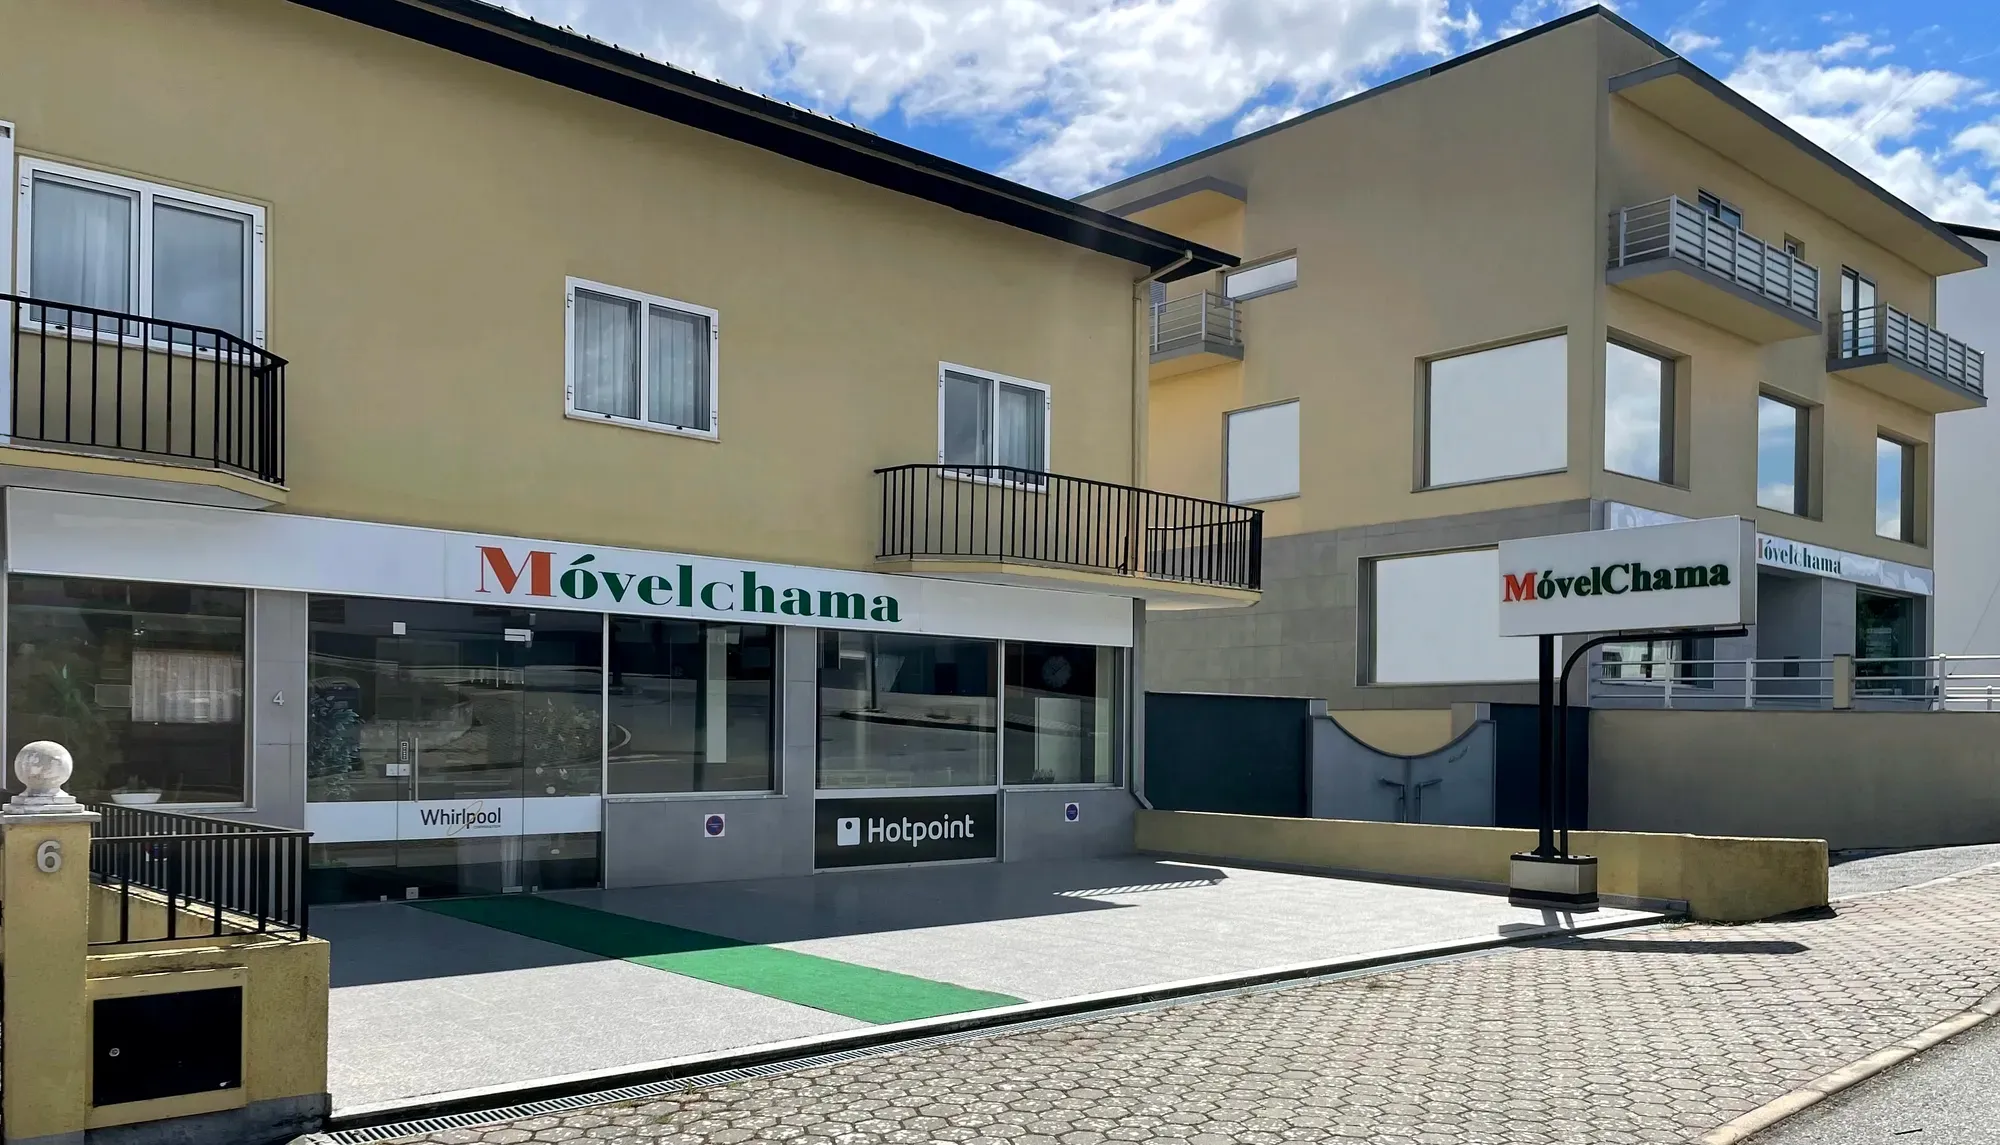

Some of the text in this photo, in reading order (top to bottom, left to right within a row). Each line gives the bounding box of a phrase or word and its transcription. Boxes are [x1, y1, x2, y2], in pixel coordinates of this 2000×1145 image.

[475, 545, 902, 622] Móvelchama
[1503, 562, 1731, 602] MóvelChama
[272, 690, 285, 706] 4
[420, 807, 501, 829] Whirlpool
[868, 813, 975, 848] Hotpoint
[36, 840, 62, 873] 6
